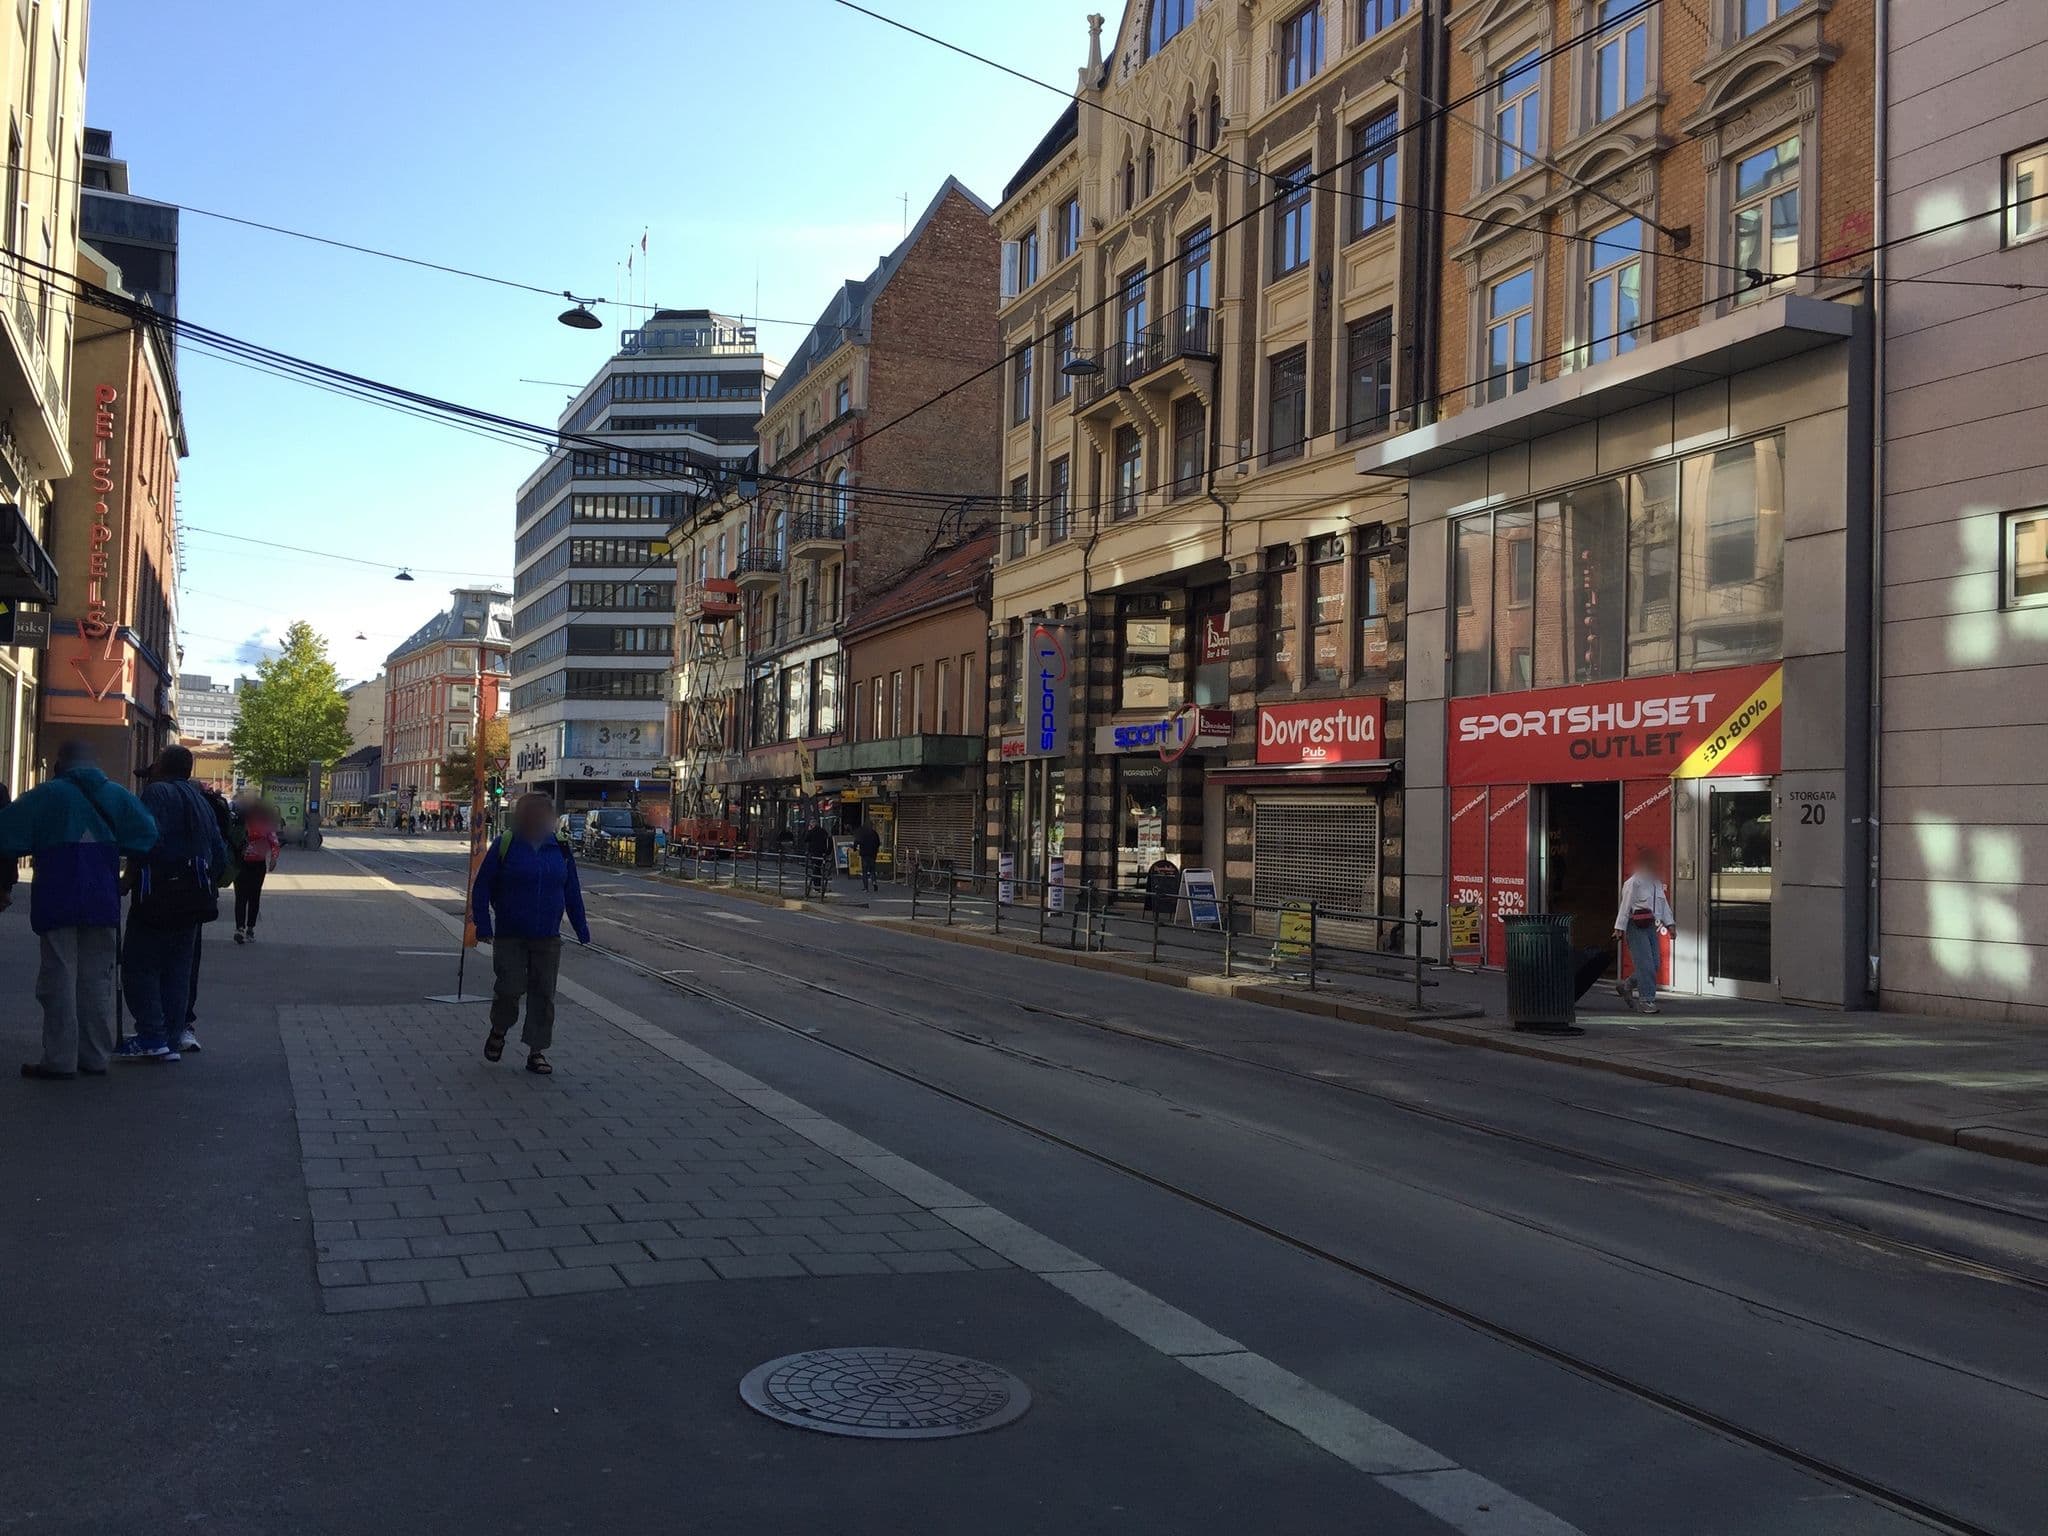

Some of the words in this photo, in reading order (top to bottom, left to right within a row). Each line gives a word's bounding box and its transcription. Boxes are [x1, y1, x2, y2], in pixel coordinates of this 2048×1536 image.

[622, 328, 757, 355] gunerius
[93, 384, 117, 493] PELS
[88, 524, 112, 637] PELS
[1041, 668, 1056, 751] sport
[1459, 694, 1716, 741] SPORTSHUSET
[599, 727, 610, 744] 3
[629, 727, 641, 744] 2
[1114, 721, 1172, 749] sport
[1262, 709, 1376, 748] Dovrestua
[1302, 746, 1327, 758] Pub
[1569, 732, 1683, 760] OUTLET
[1789, 791, 1836, 802] STORGATA
[1800, 804, 1826, 825] 20
[1454, 888, 1483, 905] -30%
[1492, 891, 1524, 908] -30%
